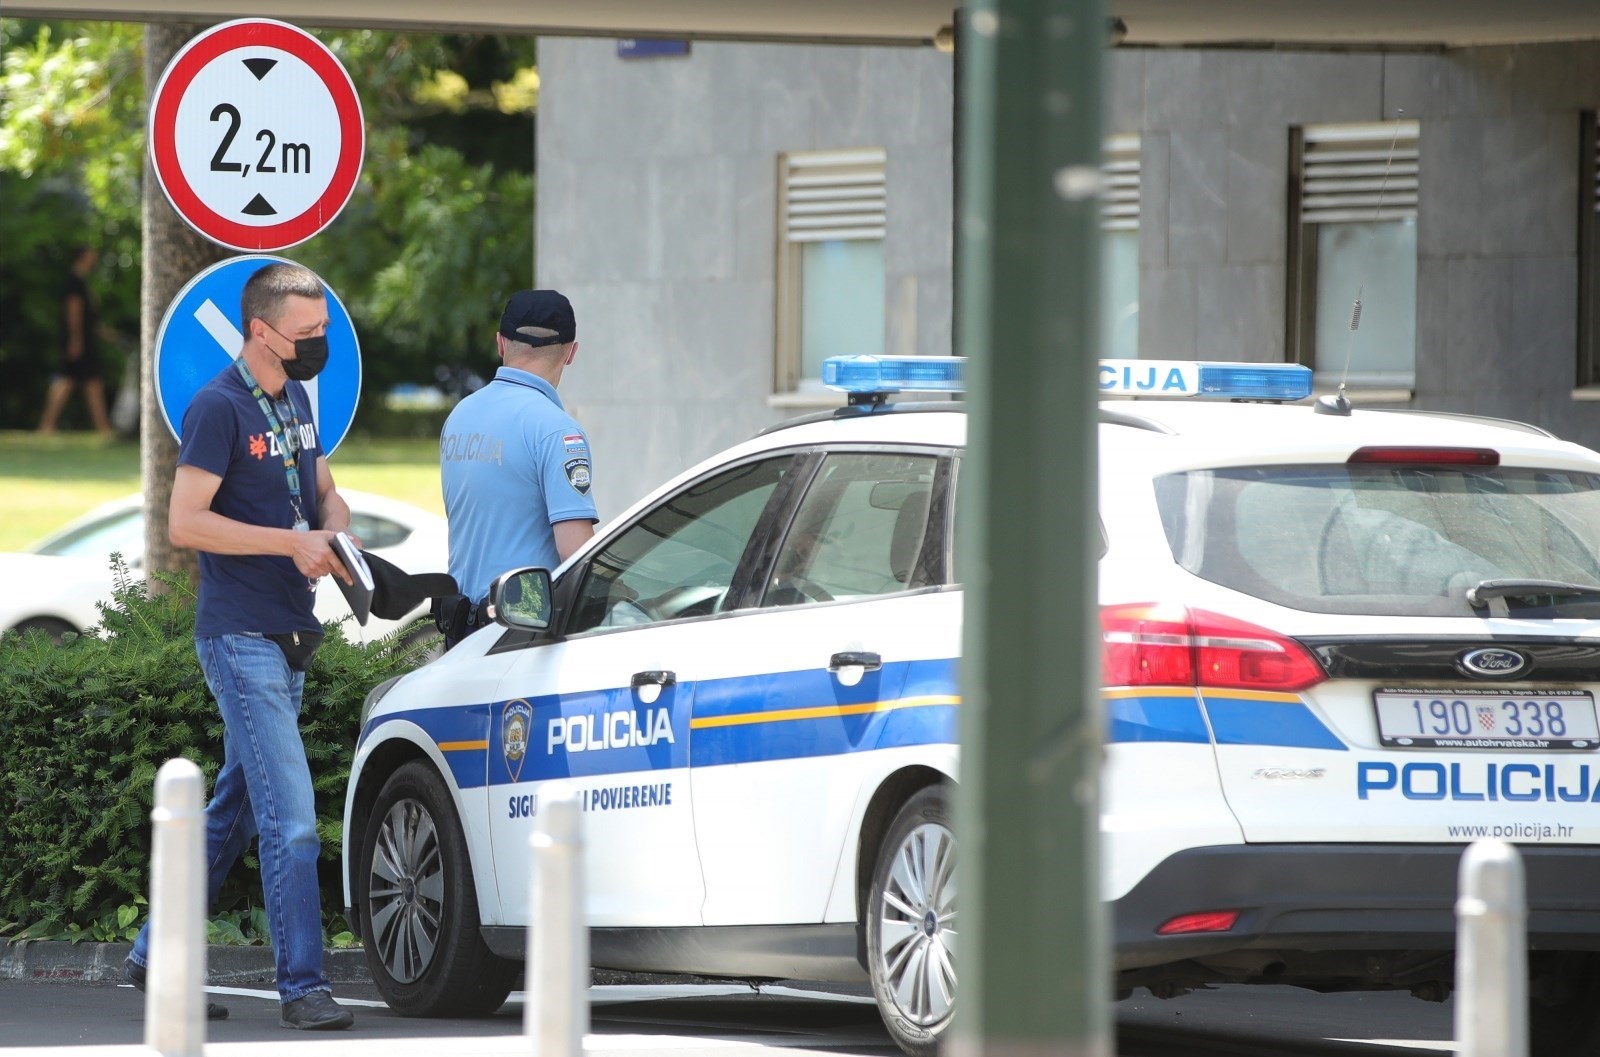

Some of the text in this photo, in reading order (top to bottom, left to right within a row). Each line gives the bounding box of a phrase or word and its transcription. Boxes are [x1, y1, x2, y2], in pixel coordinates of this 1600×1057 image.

[1098, 365, 1188, 391] CIJA
[1479, 652, 1514, 669] Ford
[505, 704, 530, 721] POLICIJA
[1412, 699, 1567, 737] 190 338
[547, 707, 676, 755] POLICIJA
[1434, 738, 1550, 749] www.autohrvatska.hr
[1357, 761, 1600, 803] POLICIJ
[591, 783, 673, 812] POVJERENJE
[1447, 822, 1575, 841] www.policija.hr
